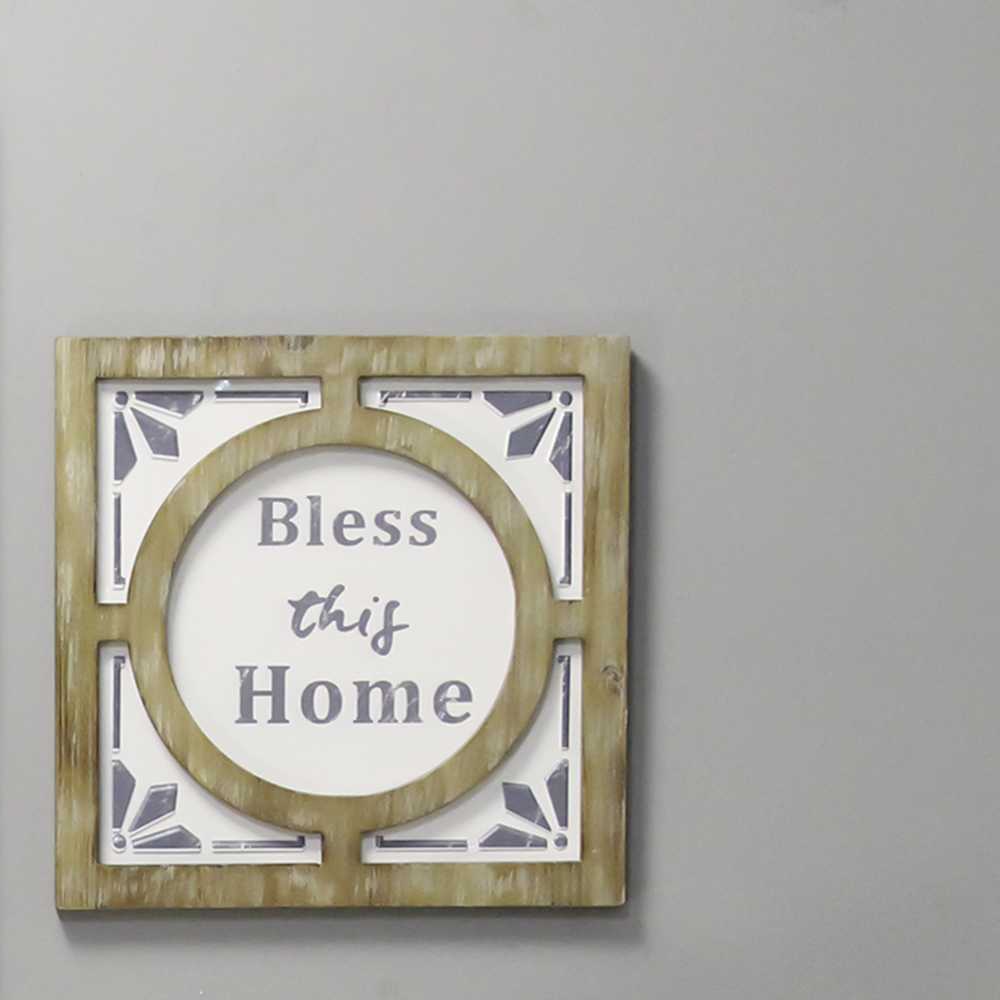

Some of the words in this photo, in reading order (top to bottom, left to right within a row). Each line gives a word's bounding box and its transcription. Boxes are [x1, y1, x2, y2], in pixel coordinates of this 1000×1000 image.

[258, 496, 437, 546] Bless
[288, 584, 409, 656] this
[235, 666, 473, 724] Home
